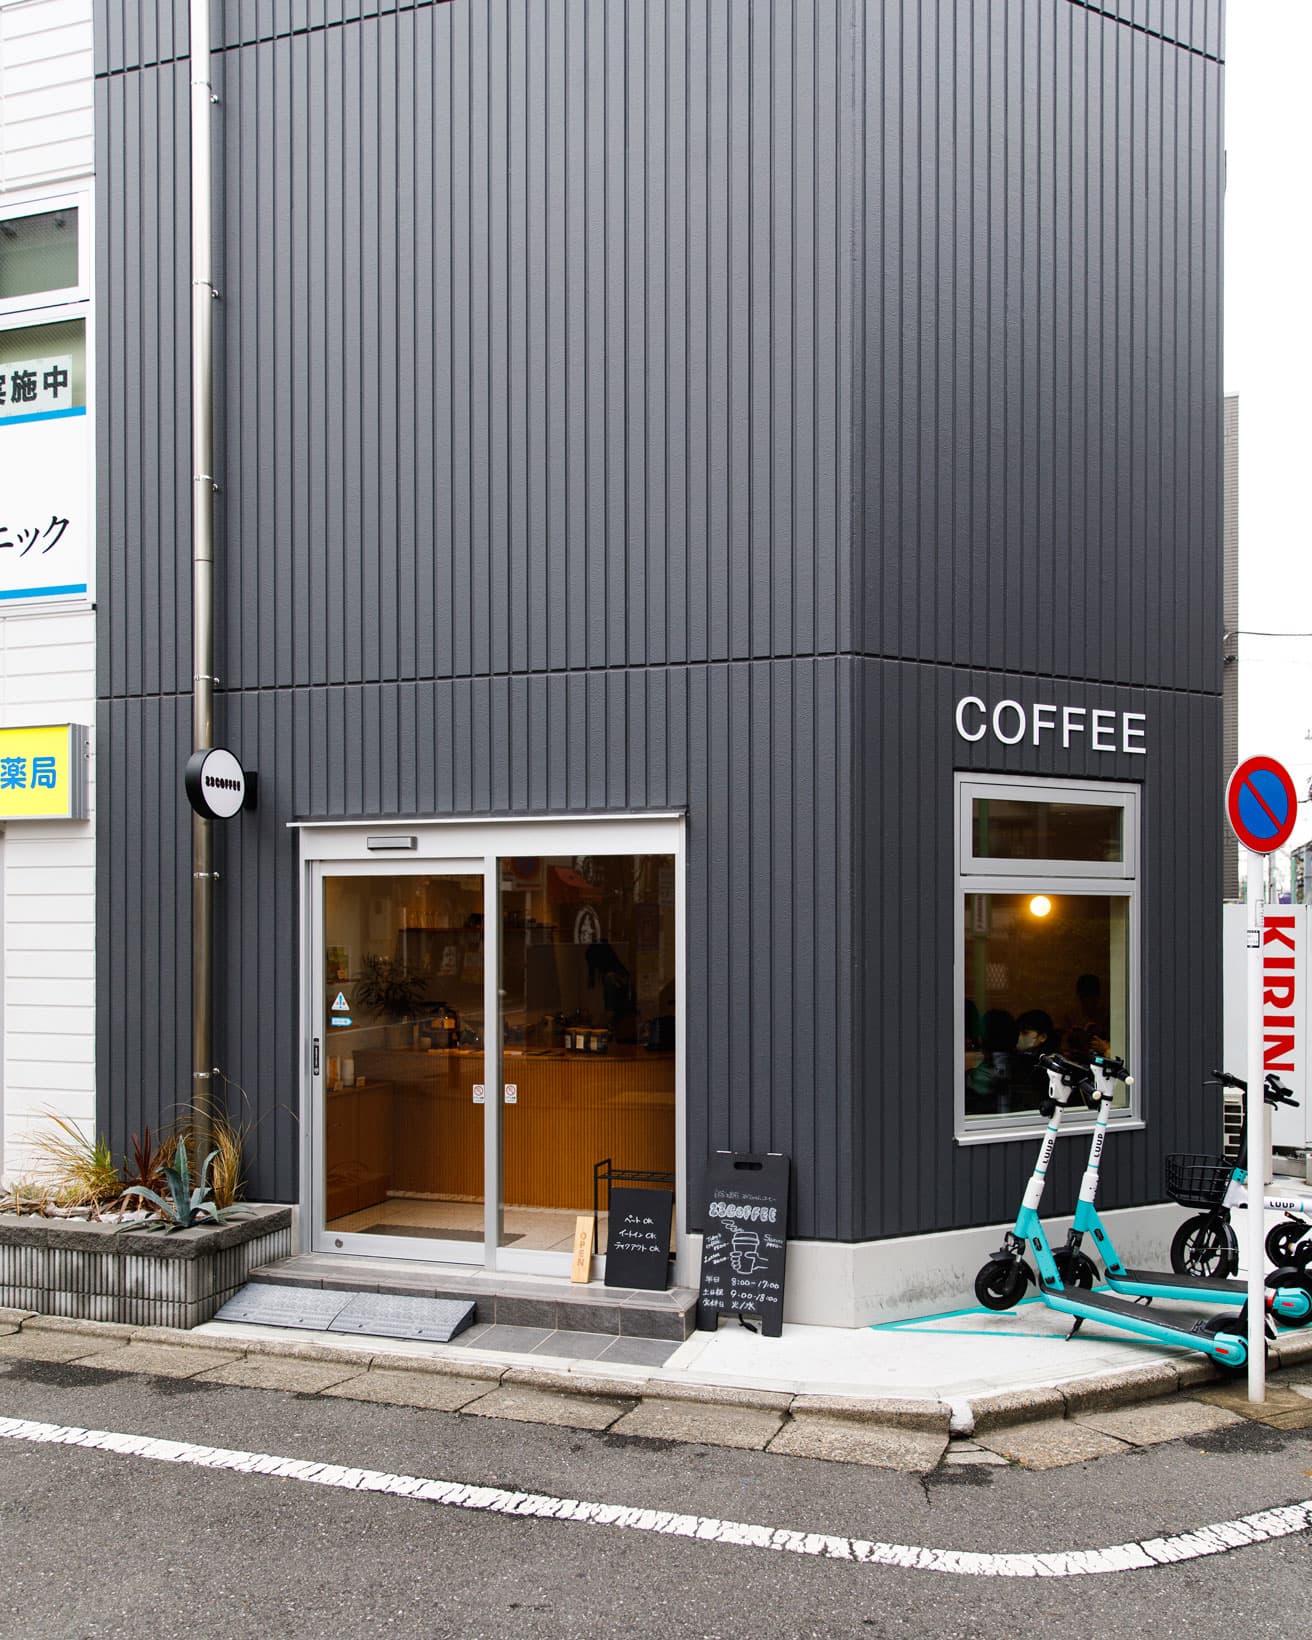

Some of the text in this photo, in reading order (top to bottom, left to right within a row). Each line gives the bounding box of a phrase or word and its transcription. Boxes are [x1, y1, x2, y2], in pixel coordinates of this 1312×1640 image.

[0, 365, 68, 405] 施中
[955, 696, 1147, 754] COFFEE
[0, 756, 57, 790] 薬局
[1263, 916, 1296, 1072] KIRIN
[1042, 1139, 1054, 1164] LUUP
[1093, 1133, 1104, 1158] LUUP
[1269, 1201, 1295, 1209] LUUP
[576, 1231, 587, 1267] OPEN
